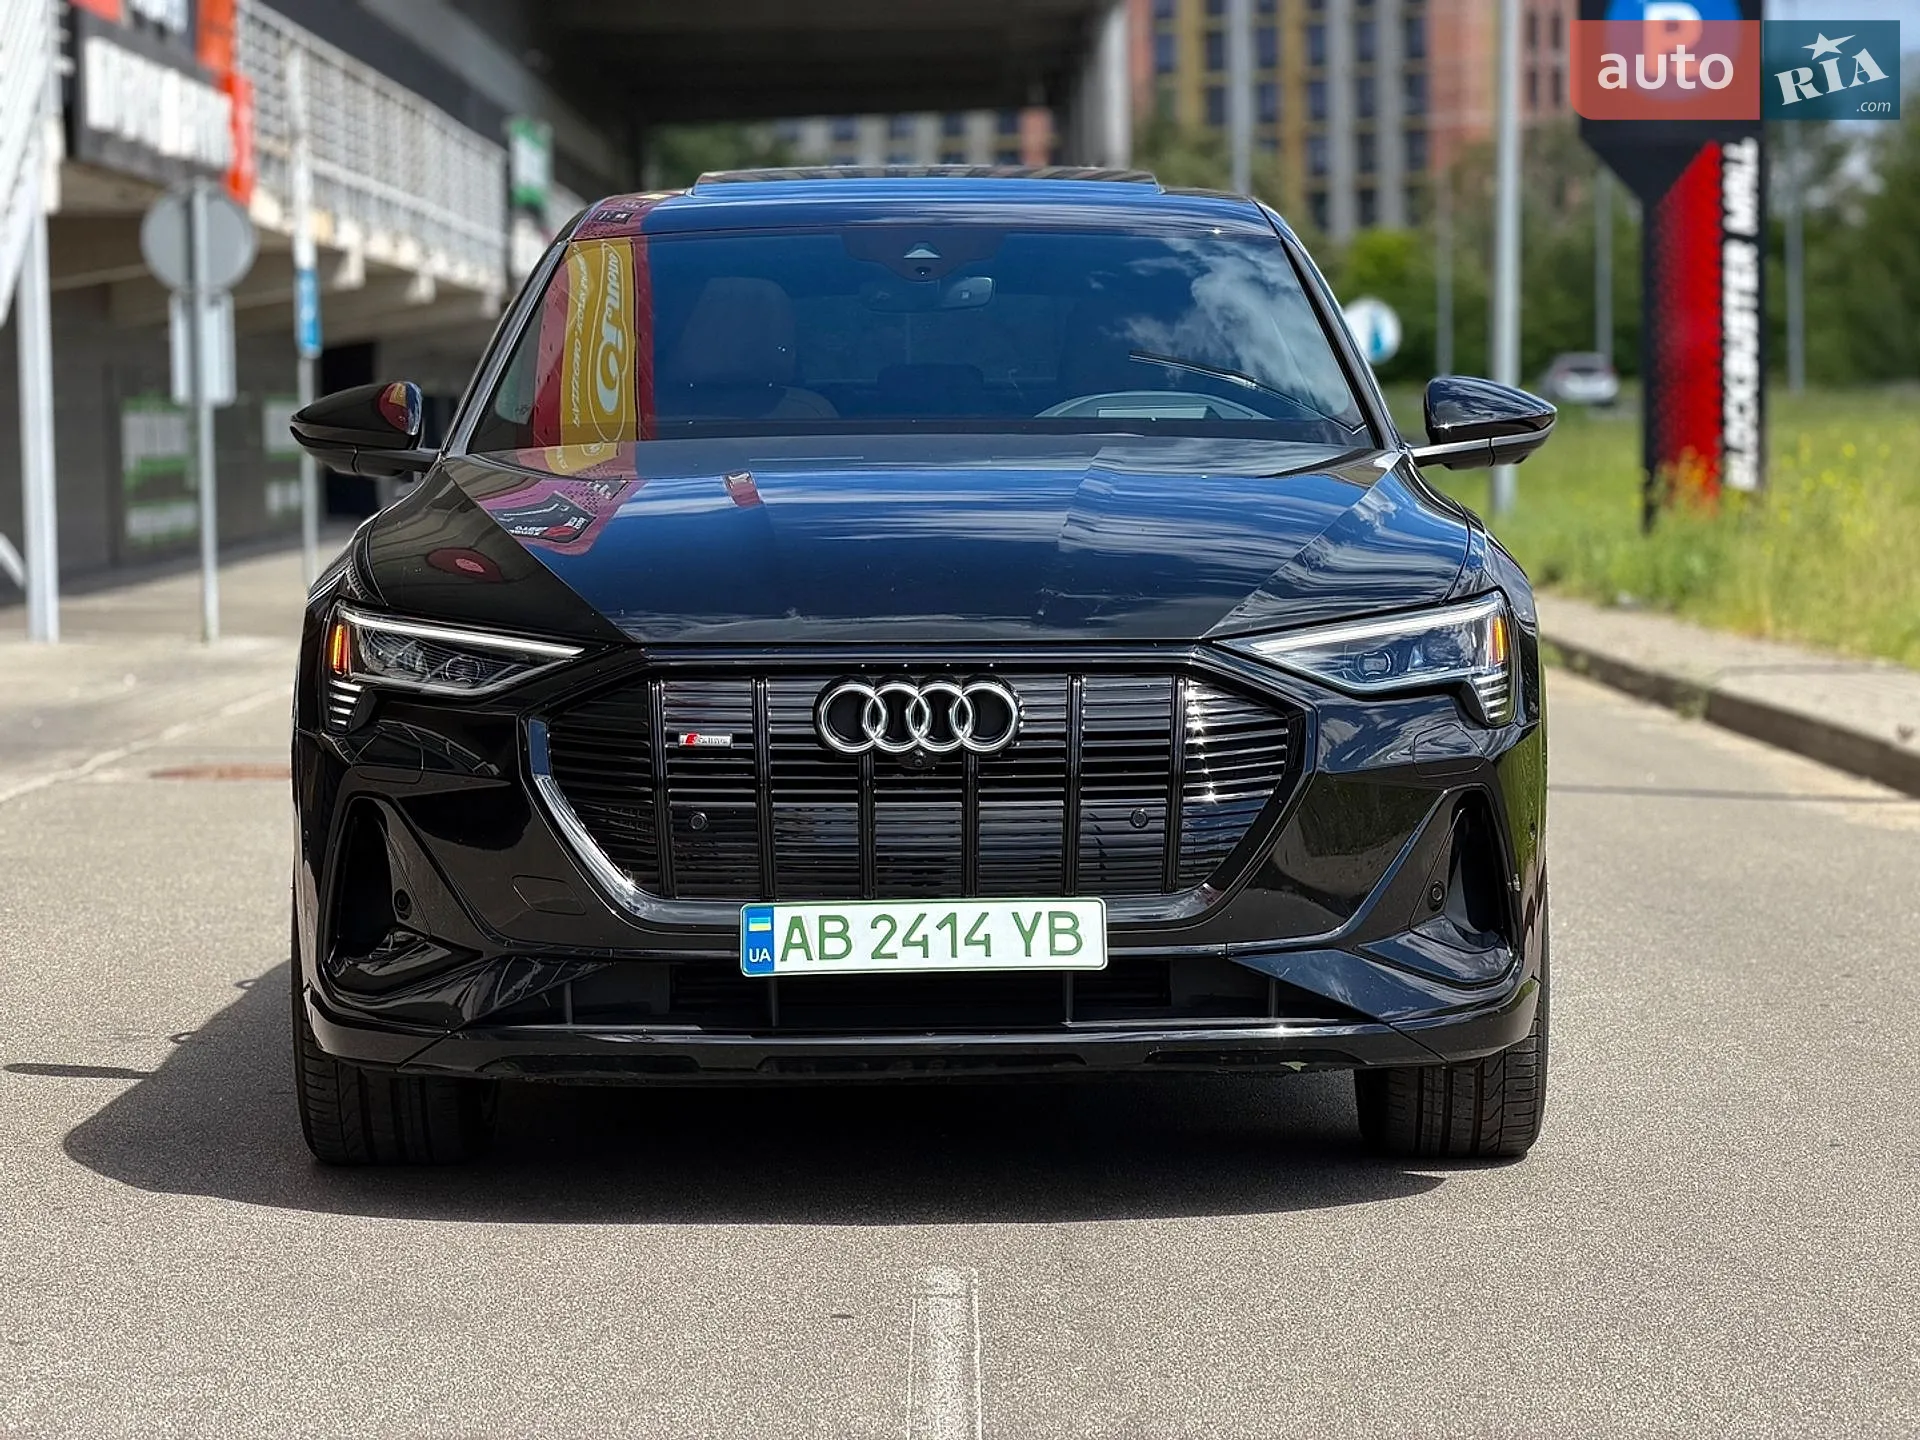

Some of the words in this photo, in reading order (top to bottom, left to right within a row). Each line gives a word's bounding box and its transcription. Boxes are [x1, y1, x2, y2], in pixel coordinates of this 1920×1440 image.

[780, 914, 853, 961] AB
[870, 911, 992, 960] 2414
[1011, 911, 1084, 957] YB
[748, 948, 772, 963] UA
